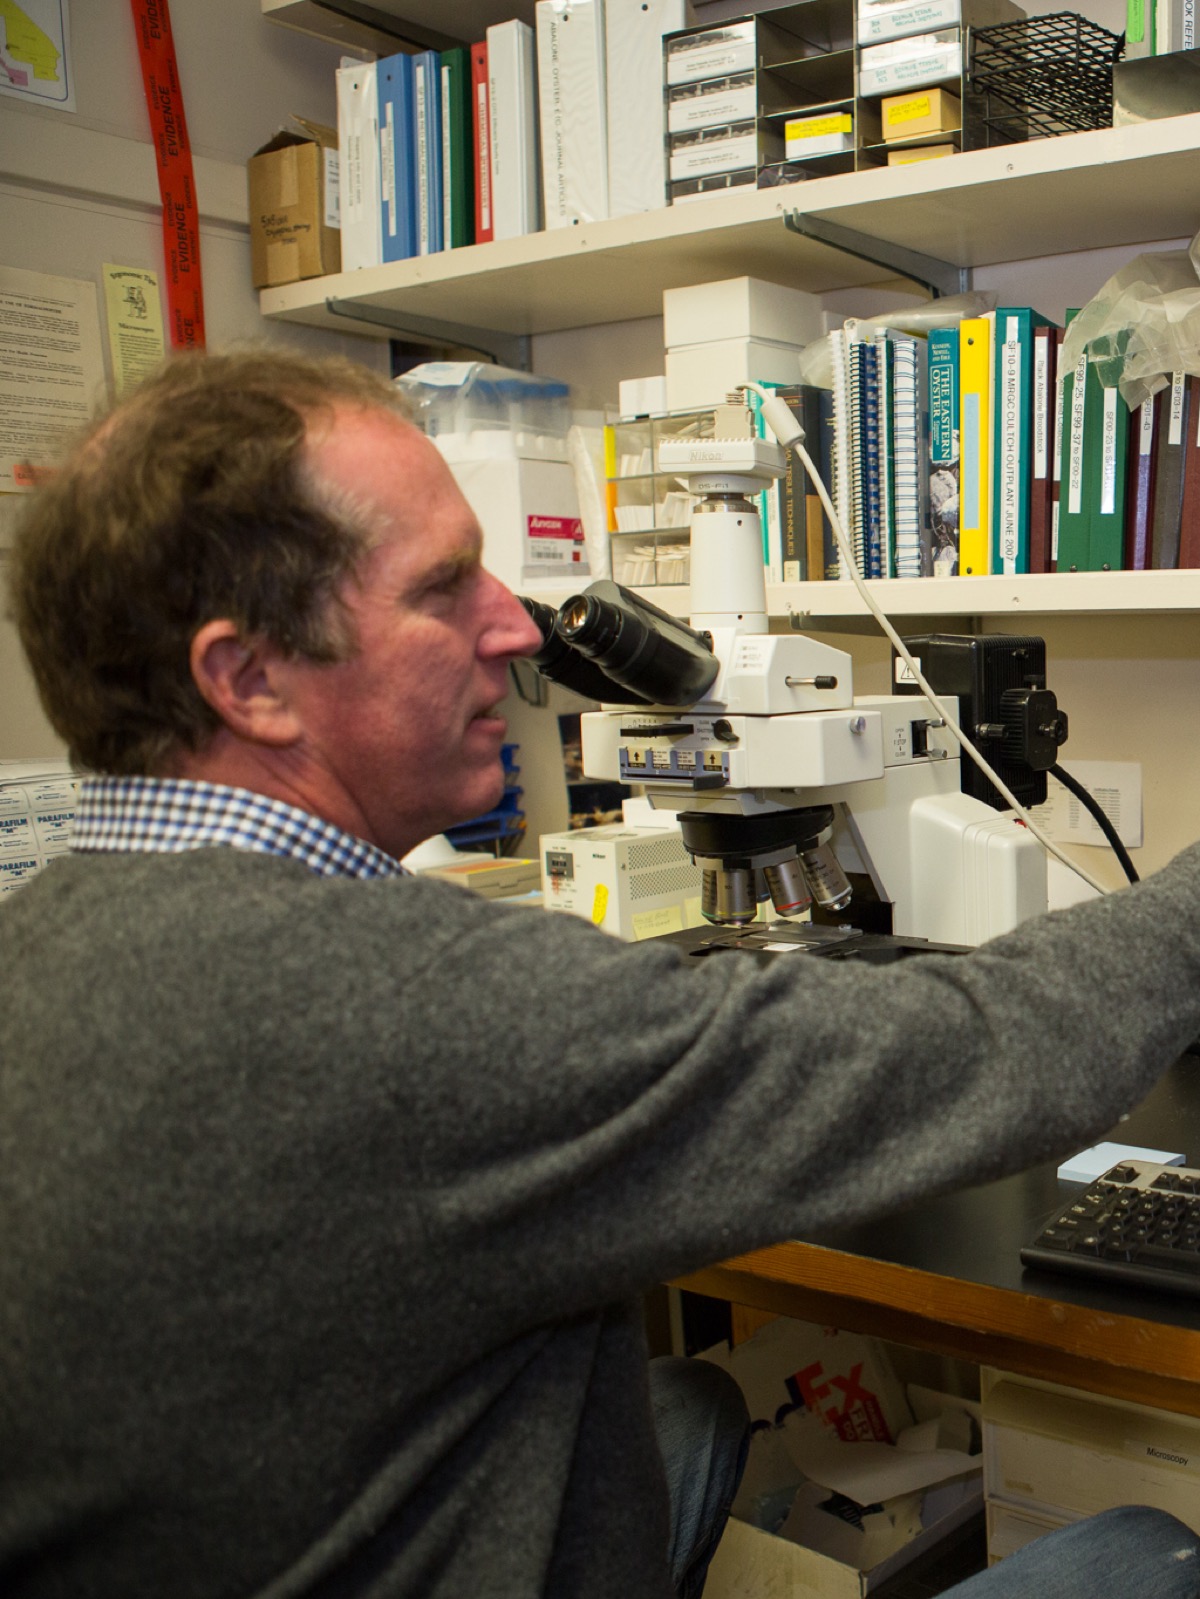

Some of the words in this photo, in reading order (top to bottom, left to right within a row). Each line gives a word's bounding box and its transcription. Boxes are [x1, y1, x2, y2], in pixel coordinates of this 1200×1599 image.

[159, 85, 179, 156] EVIDENCE
[479, 102, 488, 153] CHEMICAL
[175, 203, 190, 273] EVIDENCE
[1007, 340, 1017, 376] SF10-9
[932, 369, 941, 418] OYSTER
[940, 368, 950, 397] THE
[1007, 378, 1016, 410] MRGC
[941, 400, 953, 458] EASTERN
[1006, 411, 1015, 452] CULTCH
[1073, 404, 1082, 445] SF99-37
[690, 450, 722, 461] Nikon
[1005, 454, 1015, 508] OUTPLANT
[786, 499, 795, 556] TECHNIQUES
[1005, 510, 1014, 536] JUNE
[1005, 539, 1014, 561] 2007
[37, 813, 76, 823] PARAFILM
[1146, 1447, 1188, 1466] Microscopy
